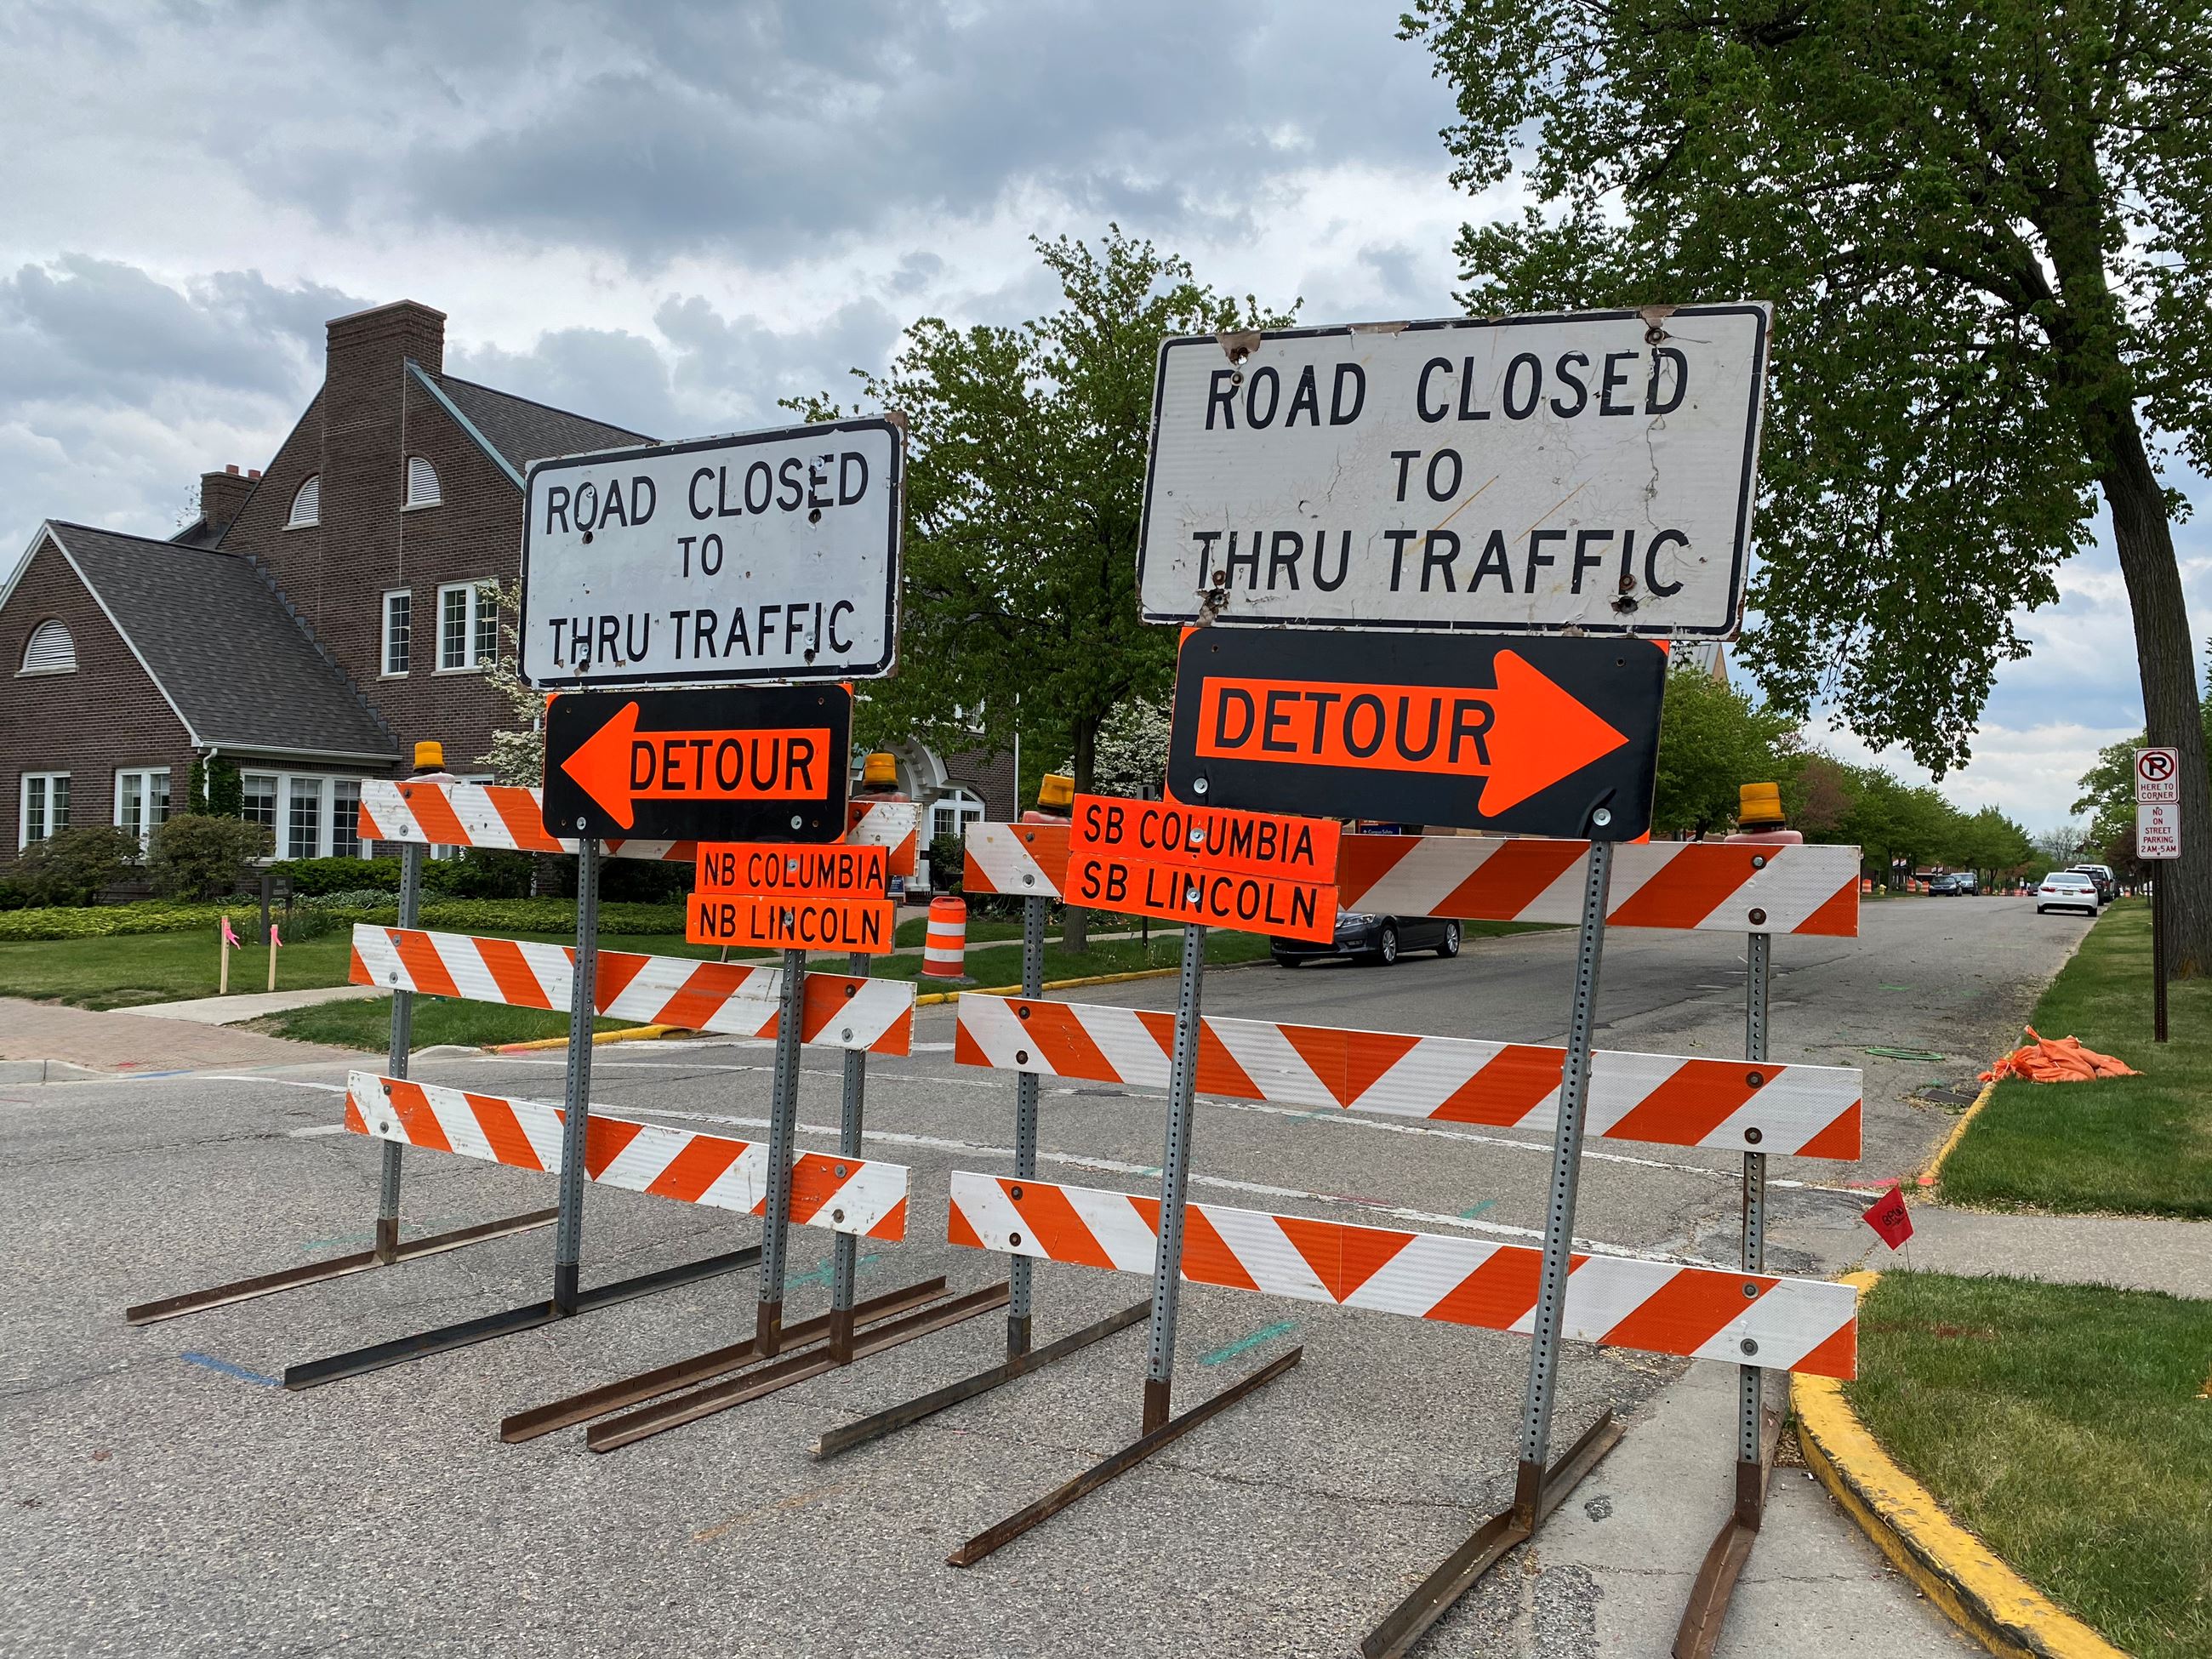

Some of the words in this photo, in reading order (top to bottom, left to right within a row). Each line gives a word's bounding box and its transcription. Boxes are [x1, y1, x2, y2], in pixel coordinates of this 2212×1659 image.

[1206, 362, 1365, 430] ROAD
[1417, 347, 1689, 424] CLOSED
[546, 476, 657, 534] ROAD
[688, 451, 869, 521] CLOSED
[1390, 449, 1462, 502] TO
[677, 533, 723, 578] TO
[1193, 529, 1352, 592] THRU
[1384, 528, 1690, 596] TRAFFIC
[549, 613, 650, 665] THRU
[670, 600, 854, 659] TRAFFIC
[1214, 687, 1496, 766] DETOUR
[630, 738, 814, 791] DETOUR
[2141, 791, 2174, 800] CORNER
[1084, 804, 1125, 844] SB
[1140, 810, 1314, 866] COLUMBIA
[704, 852, 735, 887] NB
[748, 853, 882, 890] COLUMBIA
[1080, 861, 1128, 902] SB
[1145, 868, 1317, 928] LINCOLN
[699, 904, 736, 937] NB
[750, 905, 880, 945] LINCOLN
